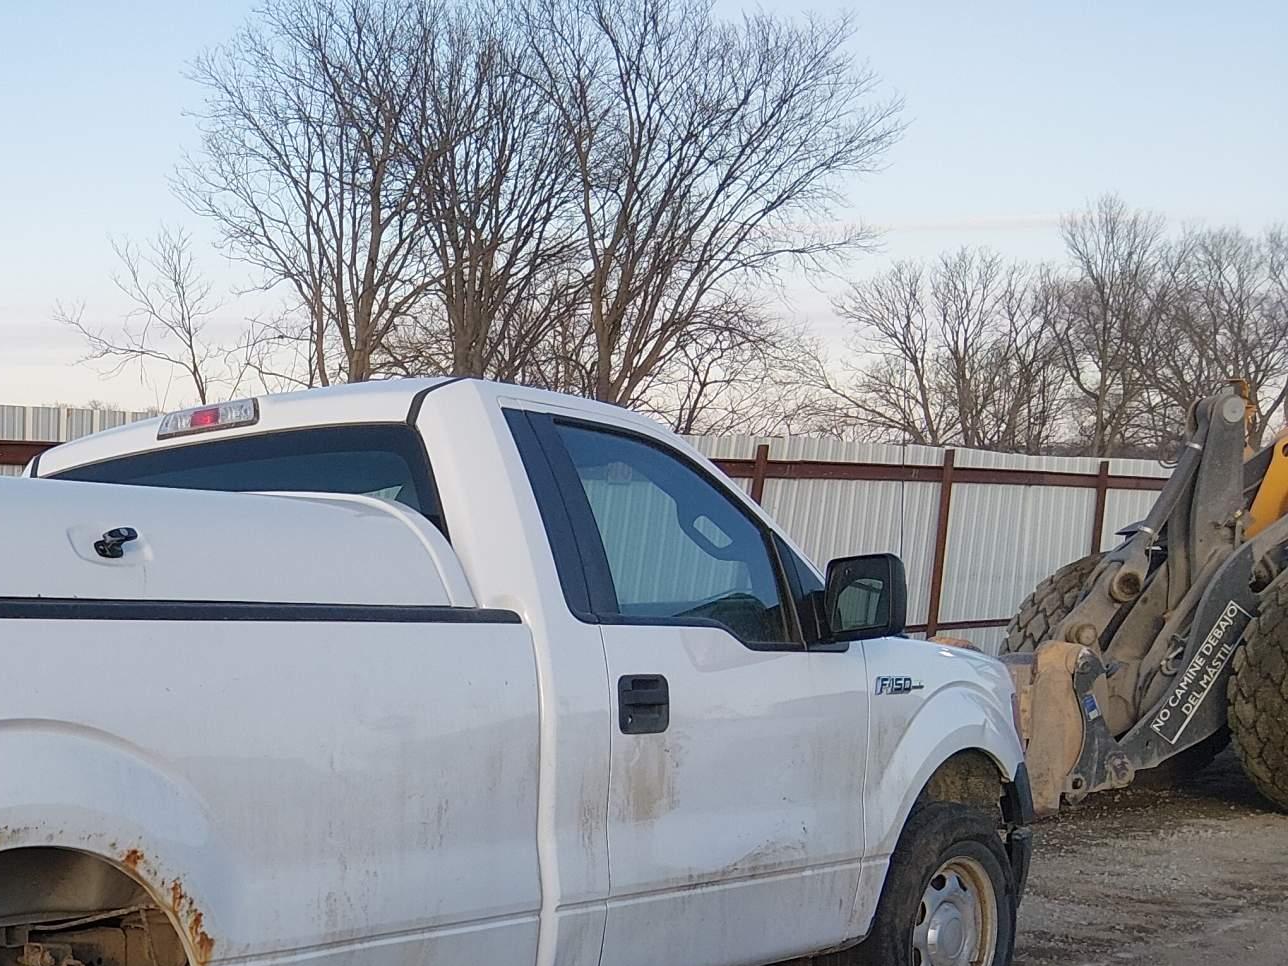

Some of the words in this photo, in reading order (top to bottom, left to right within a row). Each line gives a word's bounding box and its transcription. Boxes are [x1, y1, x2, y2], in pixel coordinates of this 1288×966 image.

[1152, 708, 1171, 732] NO
[1168, 655, 1206, 707] CAMINE
[1201, 605, 1239, 656] DEBAJO
[1181, 687, 1204, 716] DEL
[1199, 642, 1234, 688] MÁSTIL
